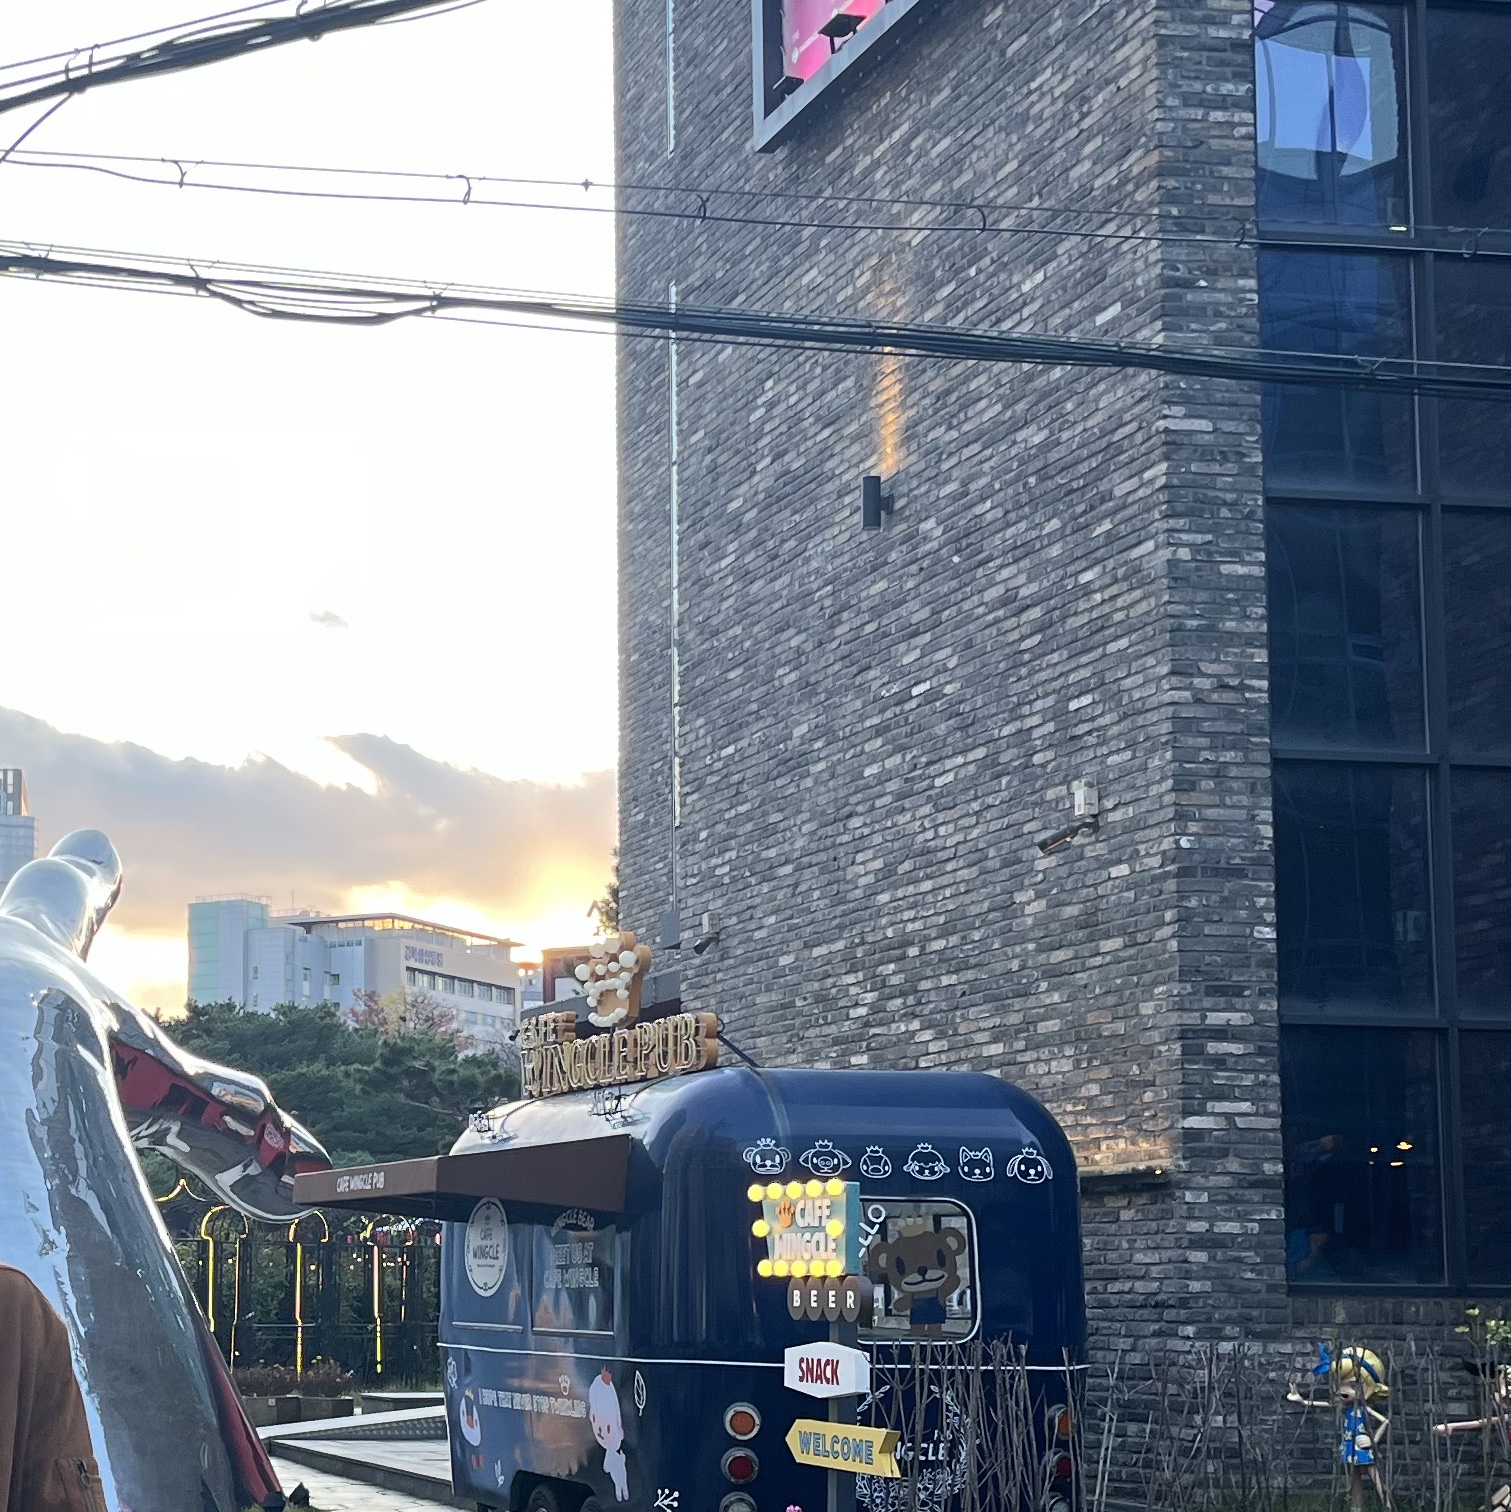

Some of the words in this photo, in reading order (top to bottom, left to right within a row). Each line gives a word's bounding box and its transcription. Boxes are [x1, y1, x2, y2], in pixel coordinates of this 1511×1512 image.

[520, 1011, 556, 1049] CAFE
[520, 1029, 629, 1097] WINGCLE
[634, 1012, 697, 1076] PUB
[795, 1198, 831, 1228] CAFE
[472, 1243, 500, 1261] WINGCLE
[774, 1231, 838, 1261] WINGCLE
[792, 1289, 855, 1309] BEER
[798, 1356, 840, 1386] SNACK
[798, 1430, 874, 1466] WELCOME
